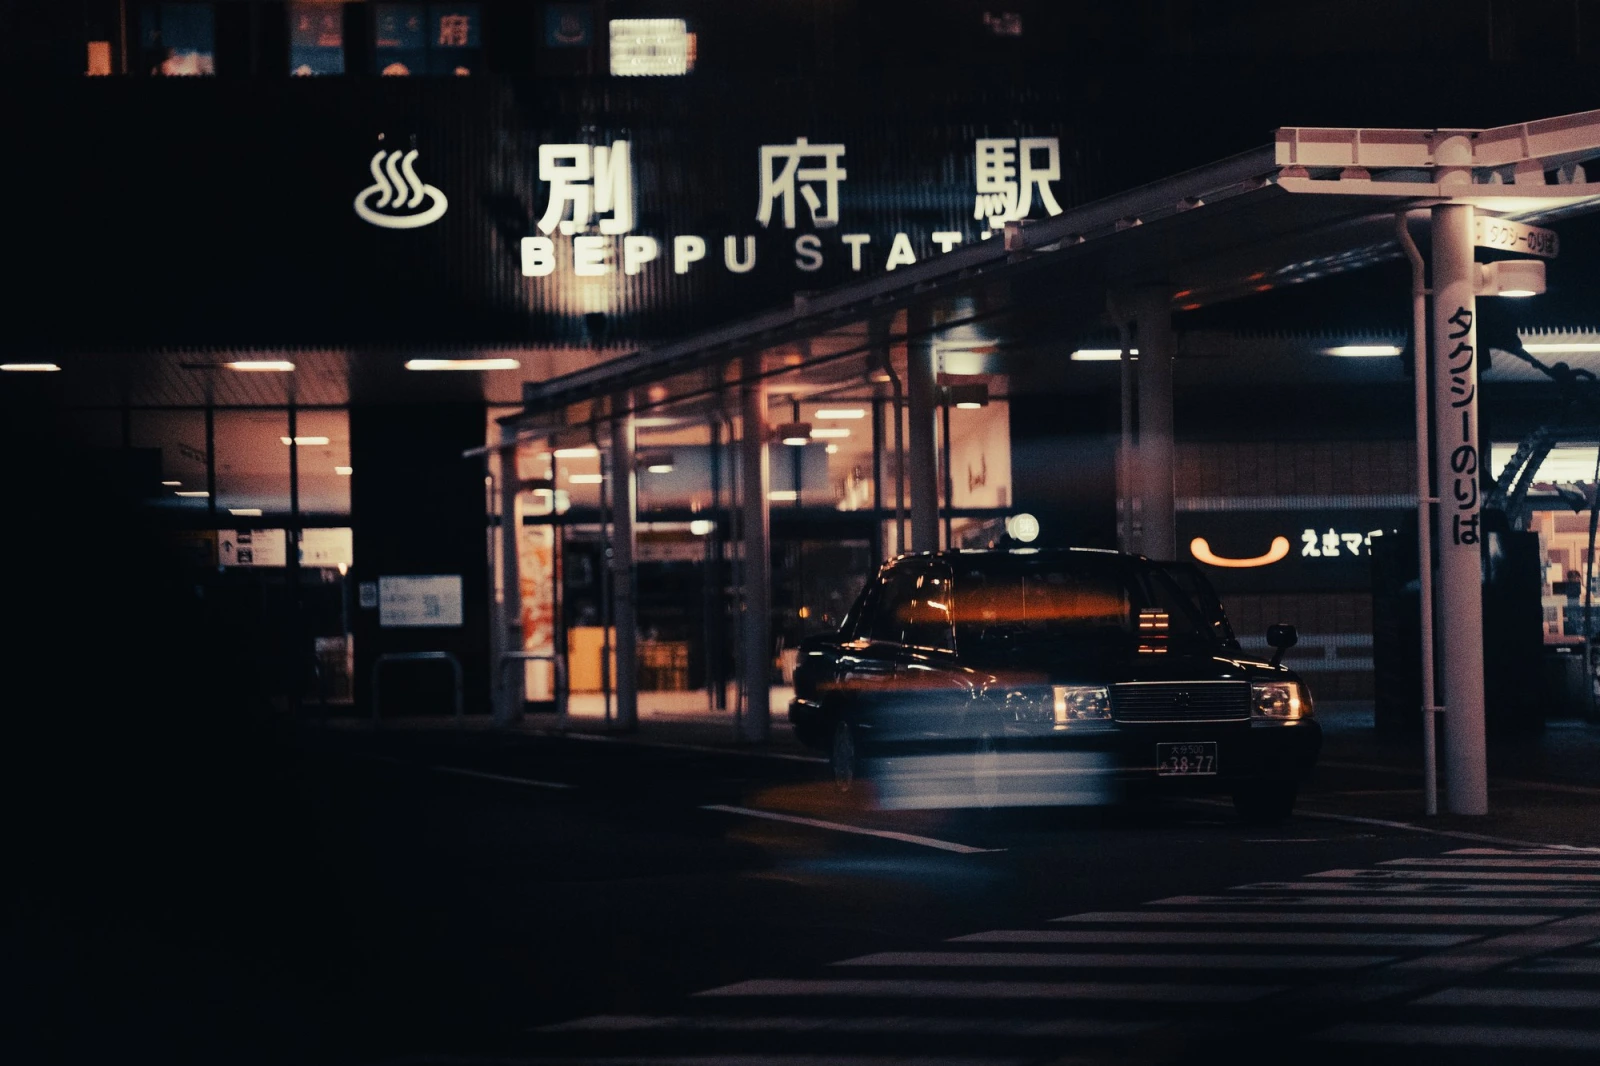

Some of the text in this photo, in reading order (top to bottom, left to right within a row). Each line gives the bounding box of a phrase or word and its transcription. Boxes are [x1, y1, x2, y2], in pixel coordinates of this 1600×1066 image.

[537, 137, 1063, 235] 別府駅
[521, 231, 992, 277] BEPPU STAT
[1490, 226, 1555, 254] タクシーのりば
[1448, 306, 1481, 546] タクシーのりば
[1170, 756, 1214, 772] 38-77
